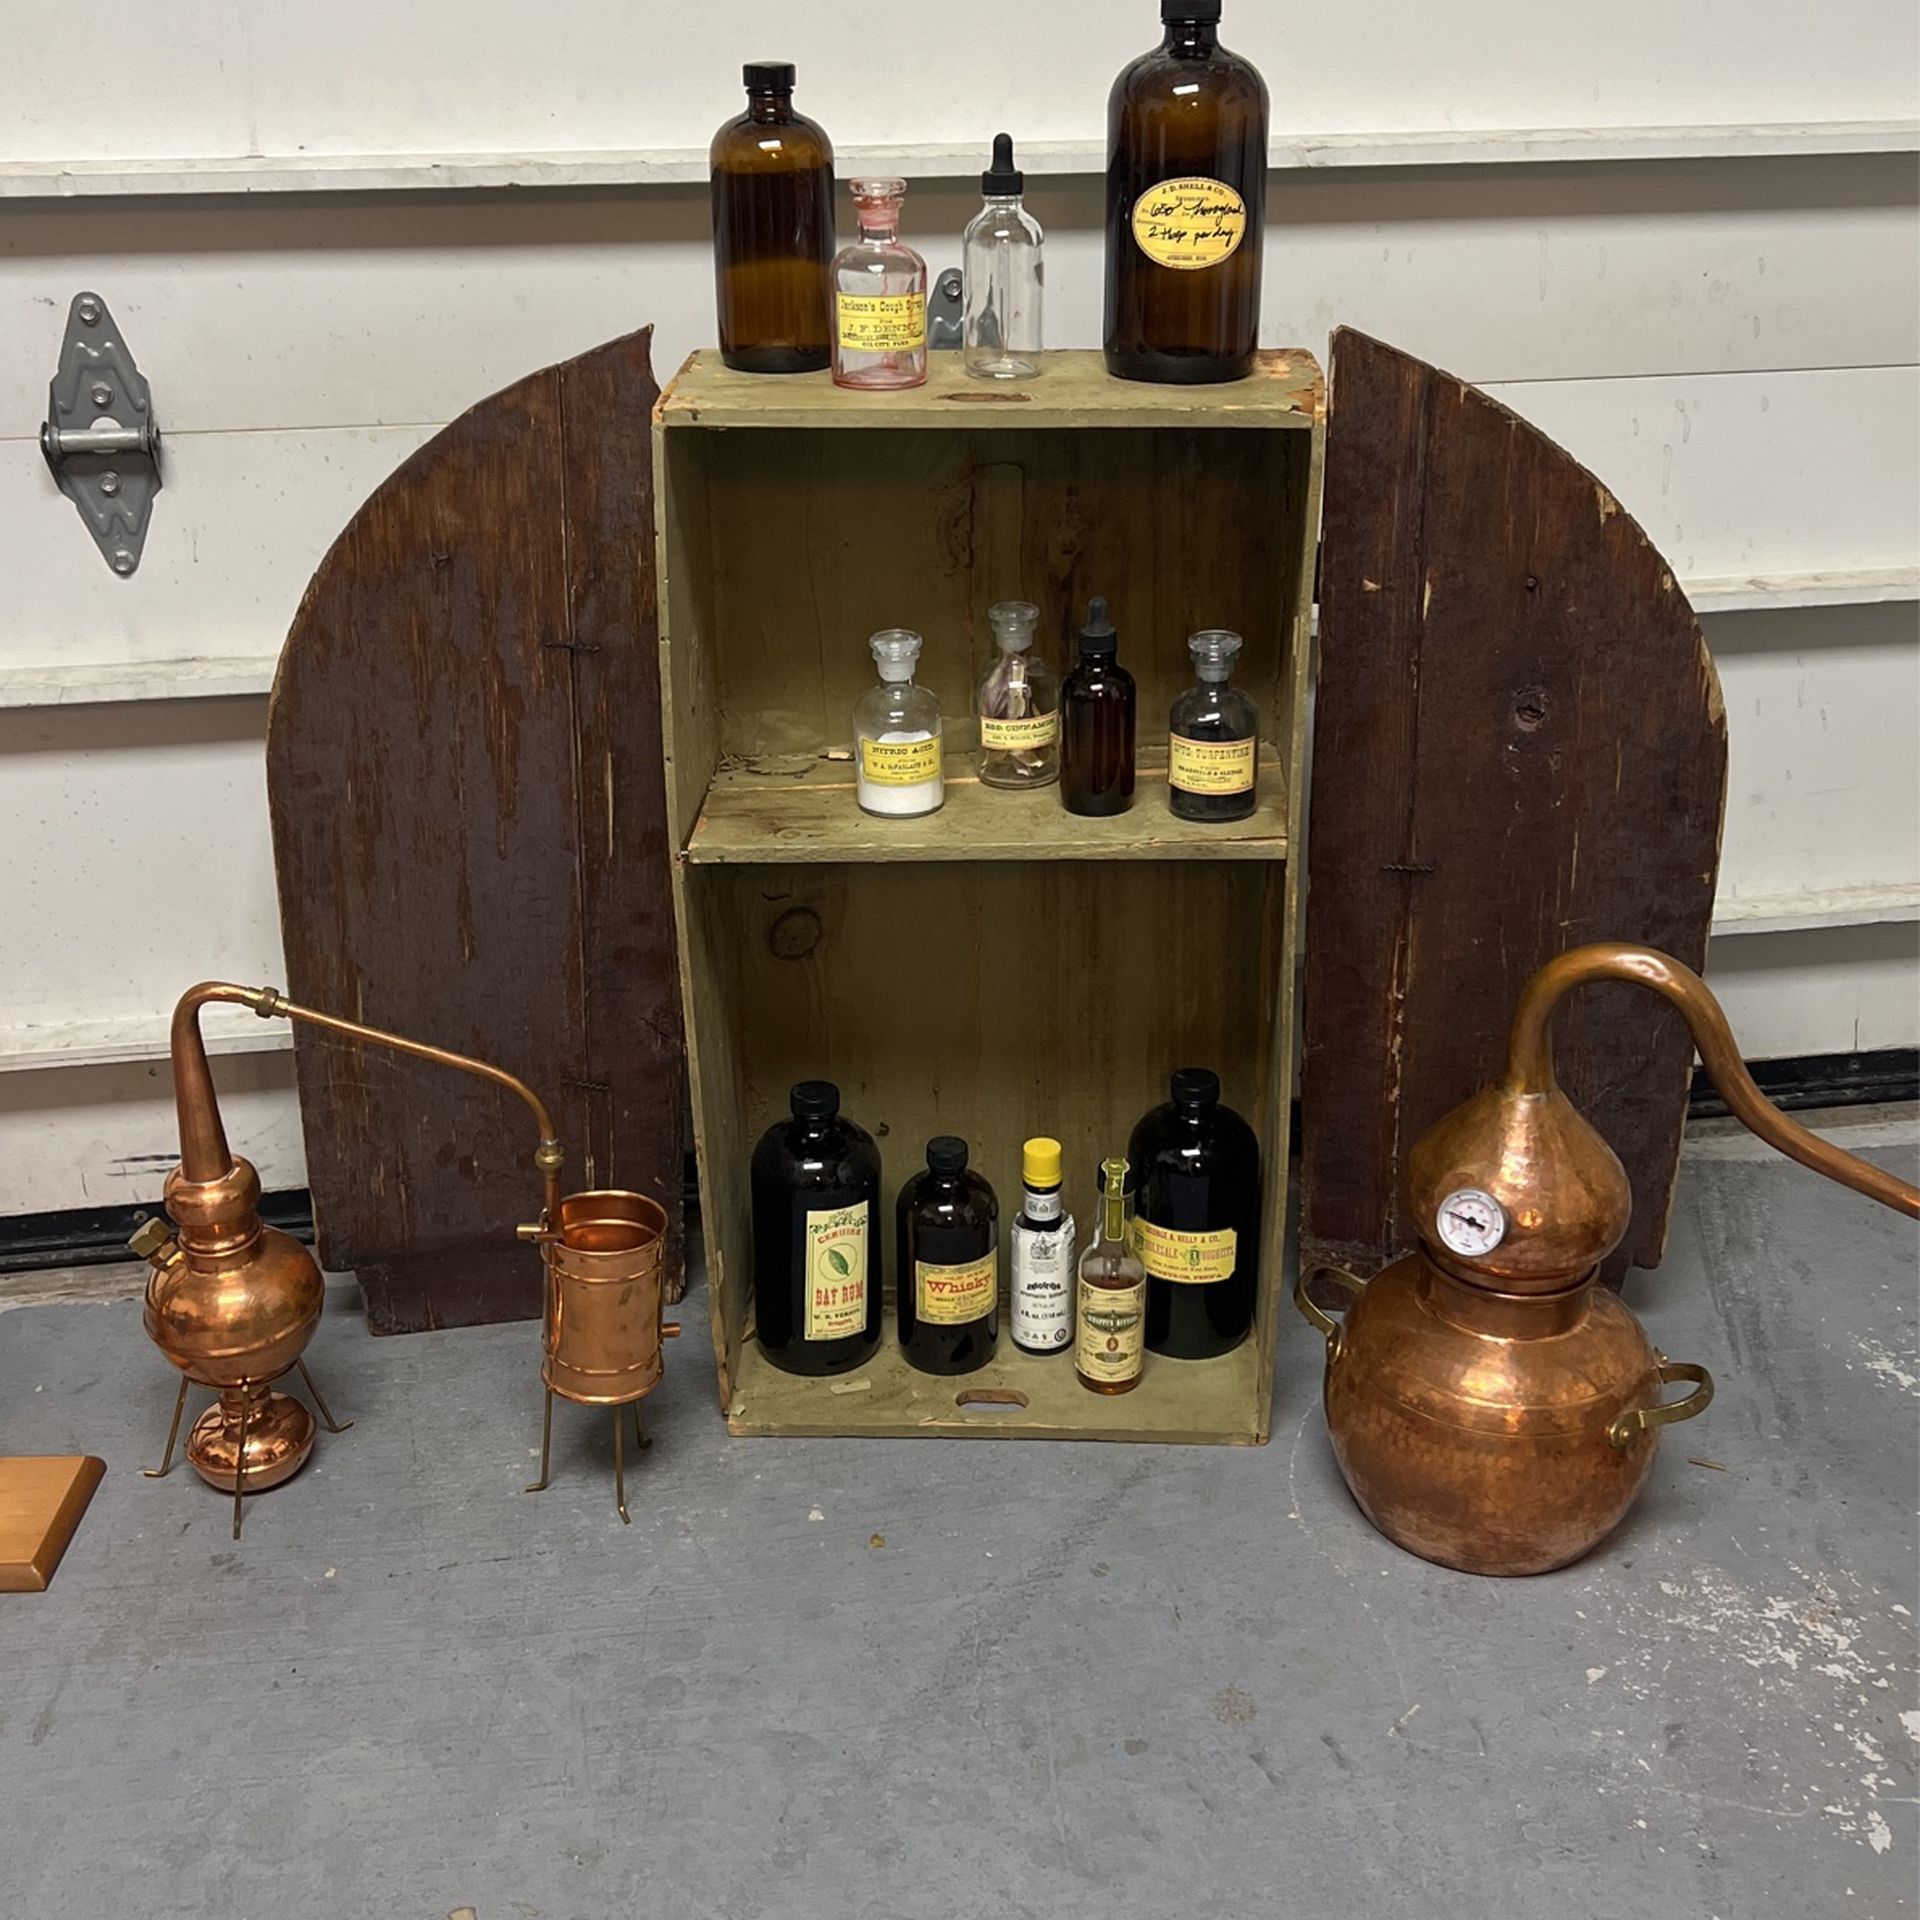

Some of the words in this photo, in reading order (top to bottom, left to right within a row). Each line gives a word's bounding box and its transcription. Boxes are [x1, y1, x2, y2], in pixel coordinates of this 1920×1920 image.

[1149, 226, 1158, 238] 2
[880, 300, 904, 314] Cough
[872, 746, 908, 755] NITRIC
[815, 1287, 838, 1307] BAY
